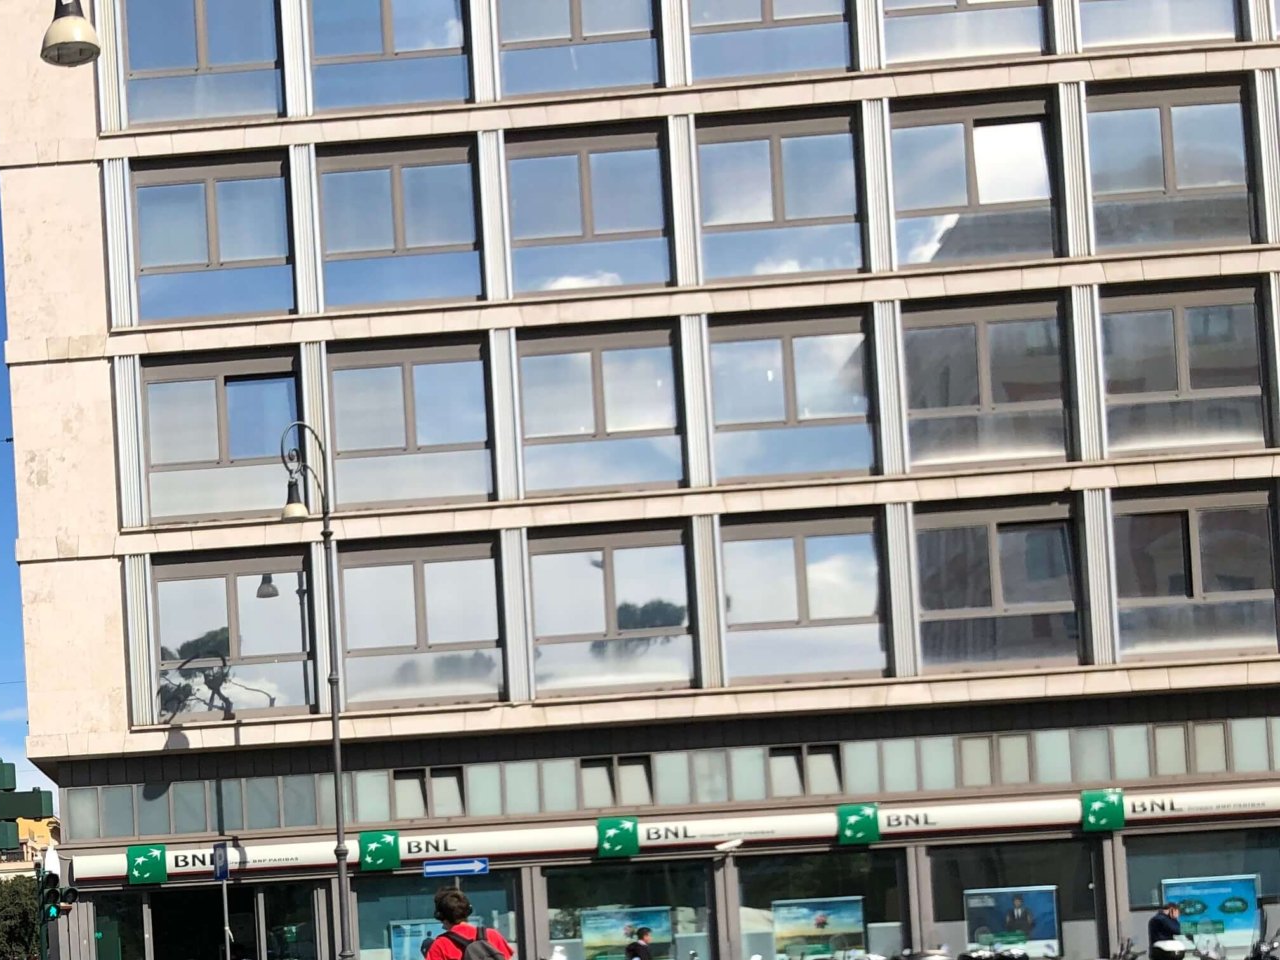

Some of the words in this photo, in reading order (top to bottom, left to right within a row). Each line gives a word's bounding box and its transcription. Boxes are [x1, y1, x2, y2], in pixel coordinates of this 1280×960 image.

[1131, 799, 1183, 814] BNL
[886, 813, 937, 827] BNL
[646, 825, 696, 840] BNL
[407, 839, 457, 854] BNL
